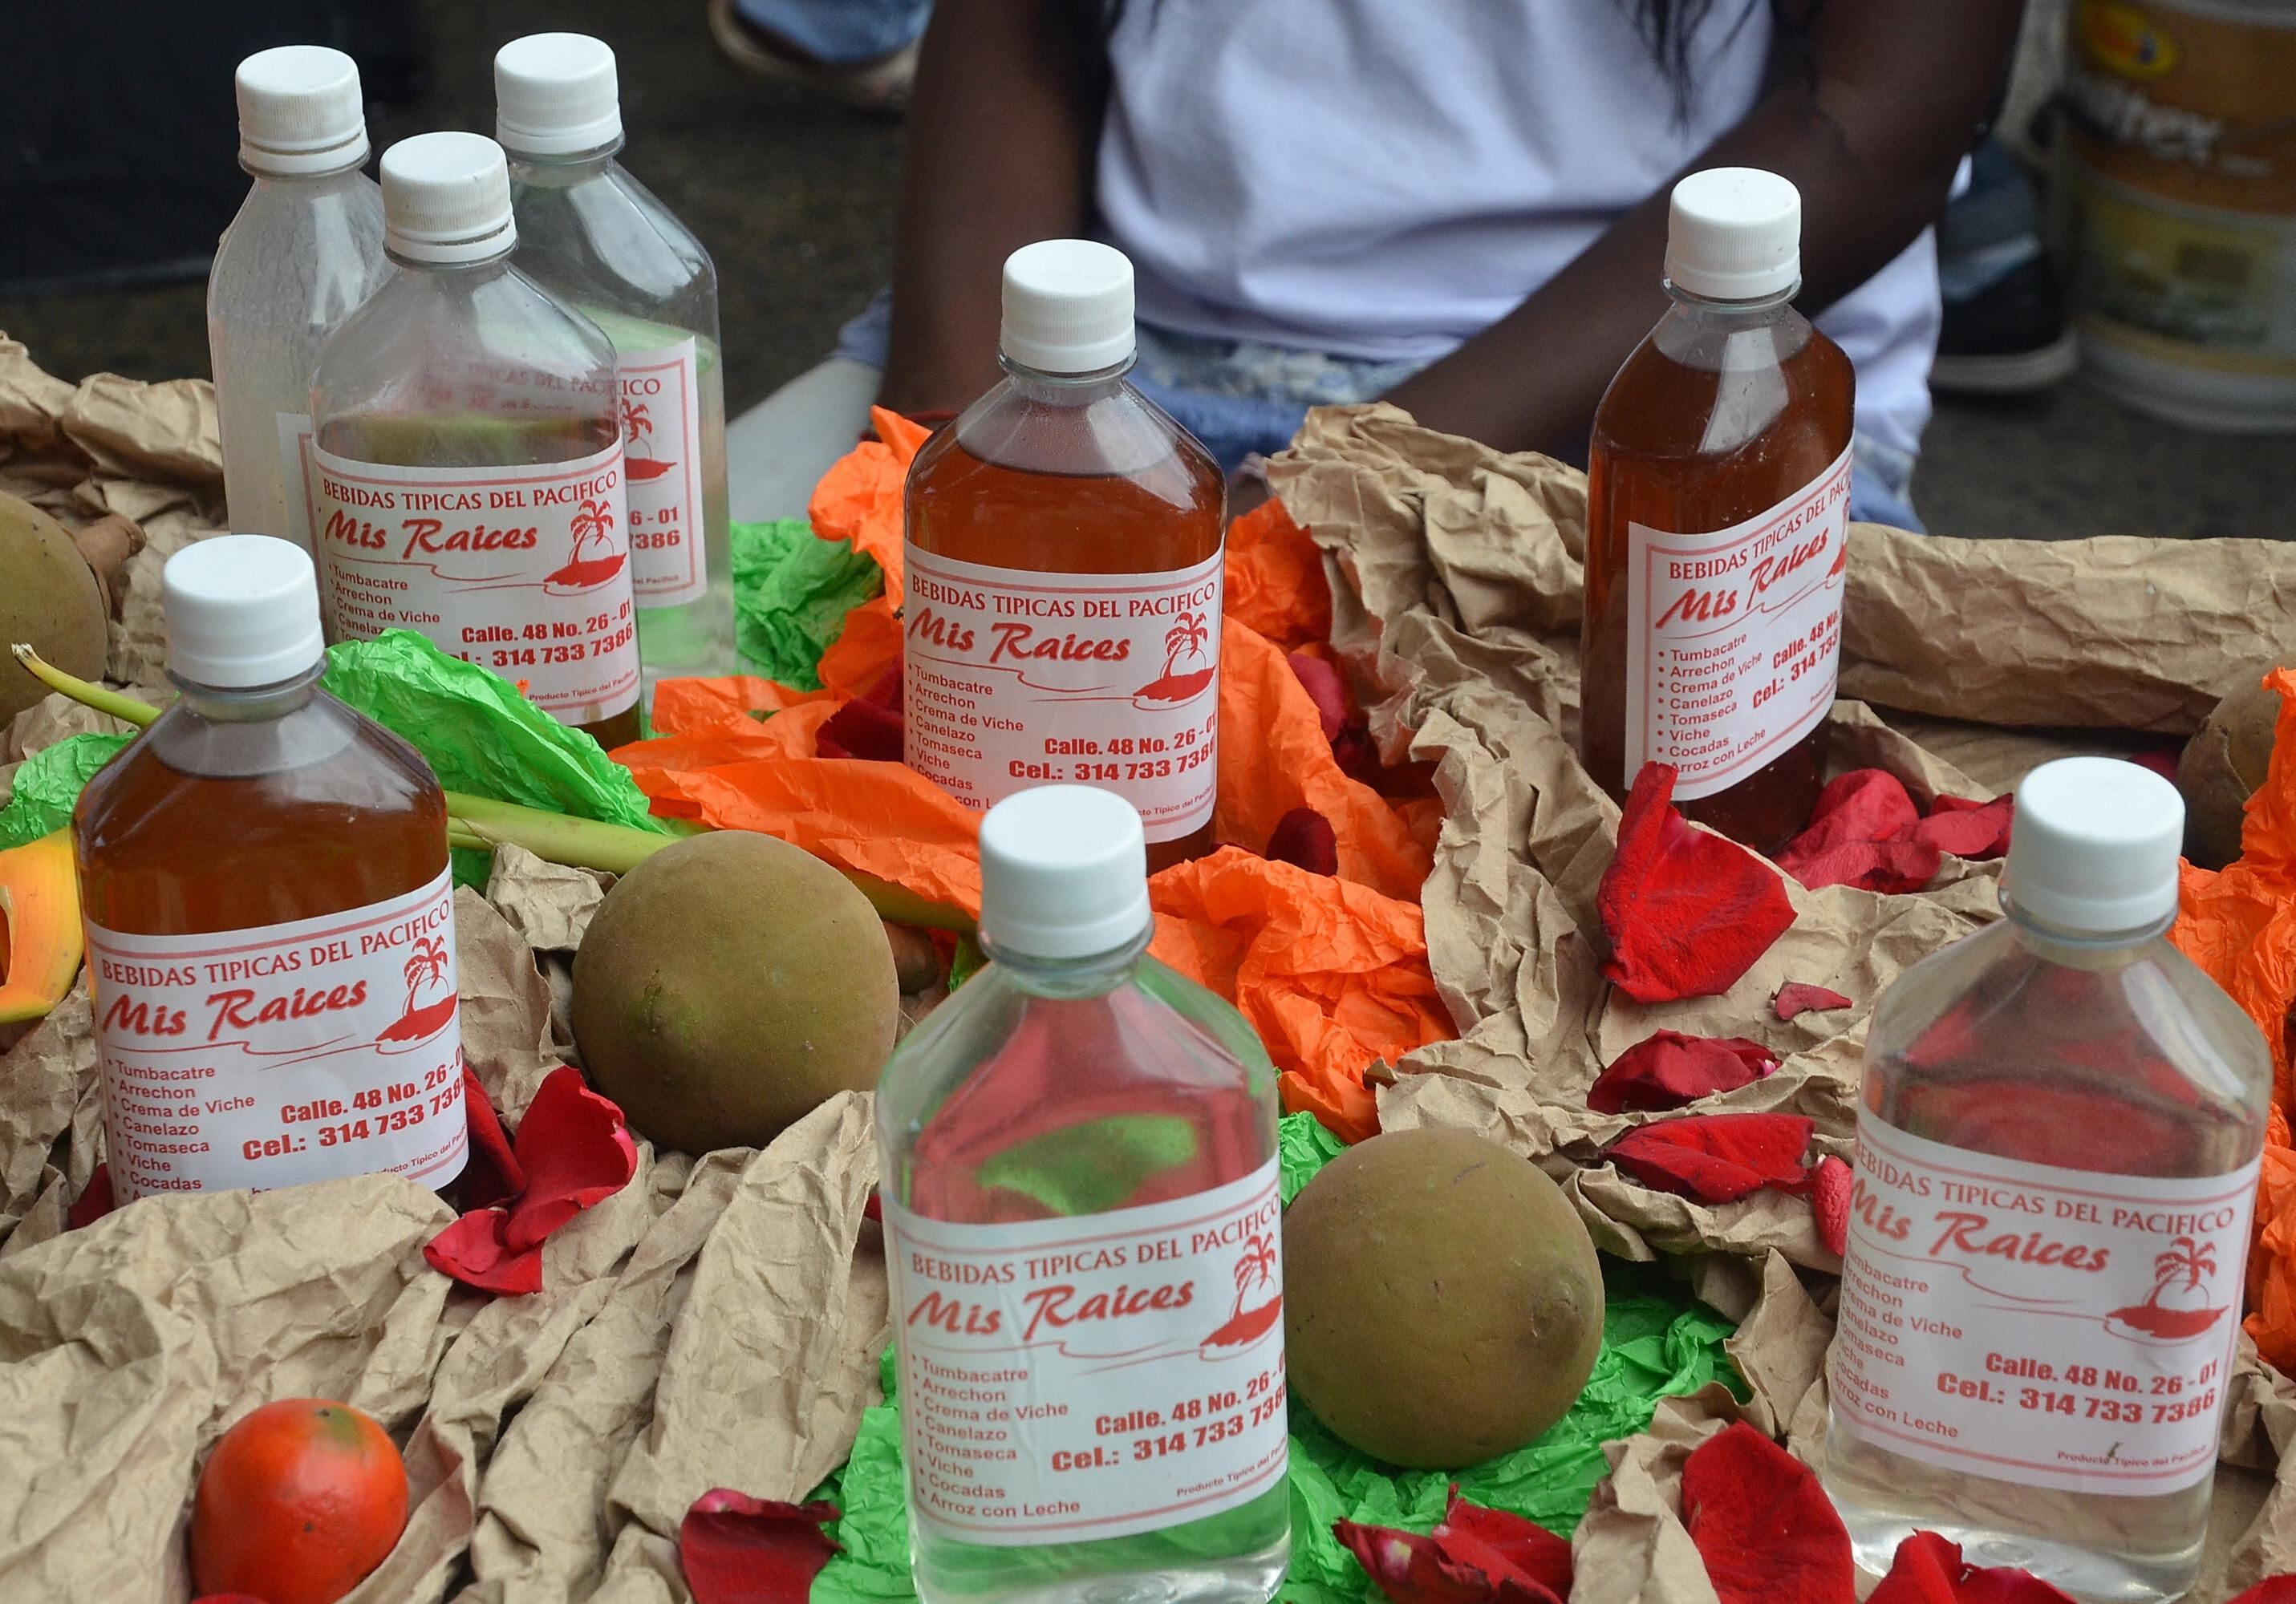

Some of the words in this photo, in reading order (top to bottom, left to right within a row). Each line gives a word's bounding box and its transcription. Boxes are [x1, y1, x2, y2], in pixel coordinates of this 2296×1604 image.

[323, 478, 396, 509] BEBIDAS
[401, 492, 482, 511] TIPICAS
[489, 490, 527, 508] DEL
[533, 470, 617, 506] PACIFICO
[658, 506, 678, 524] 01
[324, 508, 387, 550] Mis
[401, 517, 538, 561] Raices
[1669, 548, 1747, 580] BEBIDAS
[1752, 513, 1803, 559] TIPICAS
[1806, 499, 1826, 525] DEL
[333, 563, 408, 591] Tumbacatre
[1655, 587, 1738, 630] Mis
[1746, 526, 1829, 612] Raices
[335, 581, 392, 605] Arrechon
[912, 573, 986, 610] BEBIDAS
[992, 594, 1075, 618] TIPICAS
[1083, 600, 1122, 618] DEL
[1129, 581, 1215, 618] PACIFICO
[336, 597, 375, 619] Crema
[378, 609, 396, 622] de
[399, 610, 441, 623] Viche
[461, 625, 519, 643] Calle.
[522, 623, 548, 641] 48
[552, 622, 582, 638] No.
[586, 613, 609, 634] 26
[619, 598, 631, 620] 01
[338, 613, 385, 635] Canelaz
[907, 606, 976, 652] Mis
[988, 622, 1131, 664] Raices
[492, 648, 537, 667] 314
[540, 643, 586, 664] 733
[590, 622, 633, 658] 7386
[1670, 634, 1747, 662] Tumbacatre
[1773, 638, 1807, 670] Calle.
[1809, 621, 1824, 642] 48
[915, 664, 993, 695] Tumbacatre
[1669, 679, 1718, 694] Crema
[1721, 671, 1735, 685] de
[1738, 652, 1763, 675] Viche
[1670, 656, 1735, 678] Arrechon
[1791, 650, 1816, 682] 314
[528, 691, 570, 702] Producto
[598, 682, 611, 691] del
[915, 683, 976, 710] Arrechon
[1669, 689, 1734, 710] Canelazo
[915, 699, 956, 722] Crema
[959, 713, 978, 727] de
[982, 715, 1024, 731] Viche
[1669, 701, 1738, 726] Tomaseca
[916, 715, 976, 742] Canelazo
[1045, 737, 1103, 755] Calle.
[1107, 738, 1134, 755] 48
[1138, 737, 1169, 754] No.
[1174, 727, 1196, 749] 26
[1669, 727, 1710, 742] Viche
[916, 731, 983, 759] Tomaseca
[917, 746, 951, 769] Viche
[1669, 736, 1730, 758] Cocadas
[1713, 749, 1735, 766] con
[1737, 728, 1767, 755] Leche
[917, 764, 973, 791] Cocadas
[1008, 759, 1064, 780] Cel.:
[1075, 763, 1120, 780] 314
[1125, 759, 1171, 780] 733
[1182, 798, 1194, 808] del
[101, 958, 197, 986] BEBIDAS
[203, 950, 302, 983] TIPICAS
[310, 940, 353, 966] DEL
[359, 899, 449, 955] PACIFICO
[102, 993, 187, 1036] Mis
[205, 979, 367, 1042] Raices
[116, 1059, 216, 1081] Tumbacatre
[119, 1079, 196, 1100] Arrechon
[280, 1100, 348, 1124] Calle.
[352, 1089, 382, 1111] 48
[387, 1083, 421, 1104] No.
[424, 1063, 447, 1091] 26
[121, 1097, 173, 1118] Crema
[178, 1104, 200, 1117] de
[205, 1096, 255, 1114] Viche
[123, 1116, 200, 1136] Canelazo
[241, 1133, 306, 1160] Cel.:
[318, 1120, 371, 1147] 314
[375, 1104, 424, 1136] 733
[124, 1133, 210, 1154] Tomaseca
[440, 1141, 451, 1154] del
[127, 1152, 172, 1172] Viche
[129, 1170, 202, 1190] Cocadas
[1941, 1180, 2045, 1214] TIPICAS
[2055, 1199, 2103, 1225] DEL
[2112, 1206, 2235, 1234] PACIFICO
[911, 1252, 1016, 1285] BEBIDAS
[1024, 1246, 1127, 1280] TIPICAS
[1138, 1238, 1183, 1264] DEL
[1192, 1192, 1280, 1255] PACIFICO
[1852, 1177, 1913, 1241] Mis
[1928, 1210, 2111, 1273] Raices
[907, 1290, 1002, 1335] Mis
[1022, 1279, 1195, 1342] Raices
[1882, 1311, 1905, 1328] de
[1911, 1315, 1963, 1340] Viche
[922, 1356, 1028, 1383] Tumbacatre
[1985, 1351, 2058, 1383] Calle.
[2064, 1363, 2099, 1387] 48
[2104, 1371, 2144, 1394] No.
[2150, 1375, 2184, 1395] 26
[2199, 1358, 2218, 1386] 01
[923, 1377, 1006, 1402] Arrechon
[1937, 1371, 2004, 1404] Cel.:
[2019, 1387, 2076, 1416] 314
[2085, 1397, 2144, 1424] 733
[2152, 1387, 2216, 1425] 7386
[923, 1396, 980, 1422] Crema
[986, 1408, 1009, 1422] de
[1015, 1402, 1069, 1420] Viche
[1095, 1409, 1166, 1436] Calle.
[1171, 1398, 1202, 1422] 48
[1207, 1391, 1242, 1415] No.
[1247, 1371, 1270, 1401] 26
[924, 1416, 1007, 1441] Canelazo
[1864, 1401, 1897, 1422] con
[1903, 1412, 1959, 1438] Leche
[926, 1433, 1017, 1460] Tomaseca
[1052, 1446, 1119, 1472] Cel.:
[1133, 1432, 1187, 1462] 314
[1193, 1414, 1244, 1448] 733
[927, 1452, 974, 1478] Viche
[2152, 1455, 2168, 1467] del
[929, 1472, 1006, 1499] Cocadas
[1176, 1478, 1224, 1497] Producto
[930, 1492, 976, 1517] Arroz
[982, 1505, 1016, 1517] con
[1023, 1500, 1081, 1517] Leche
